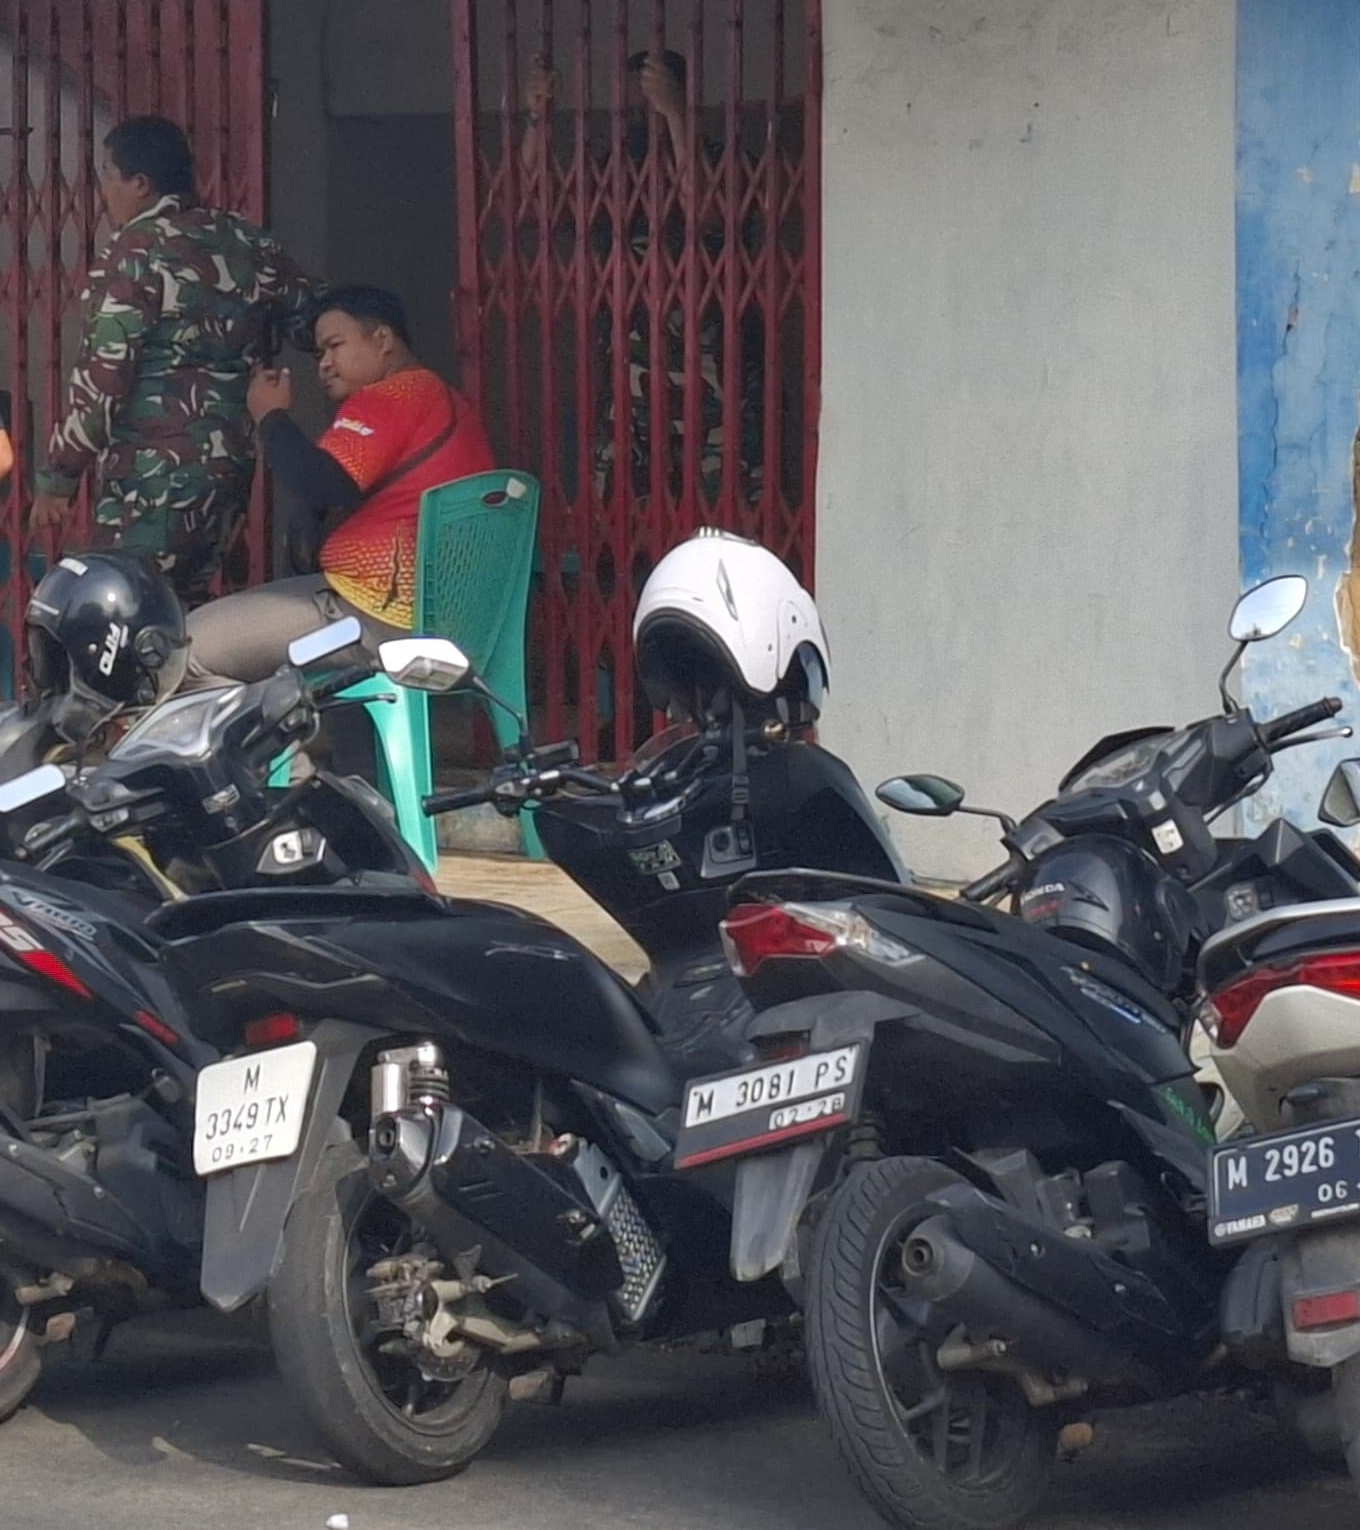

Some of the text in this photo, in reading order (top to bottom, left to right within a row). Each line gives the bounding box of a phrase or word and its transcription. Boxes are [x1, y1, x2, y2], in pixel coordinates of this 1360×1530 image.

[243, 1063, 261, 1095] M
[696, 1055, 848, 1119] M 3081 PS
[205, 1093, 290, 1141] 3349 TX
[1227, 1155, 1248, 1191] M
[1264, 1136, 1335, 1182] 2926
